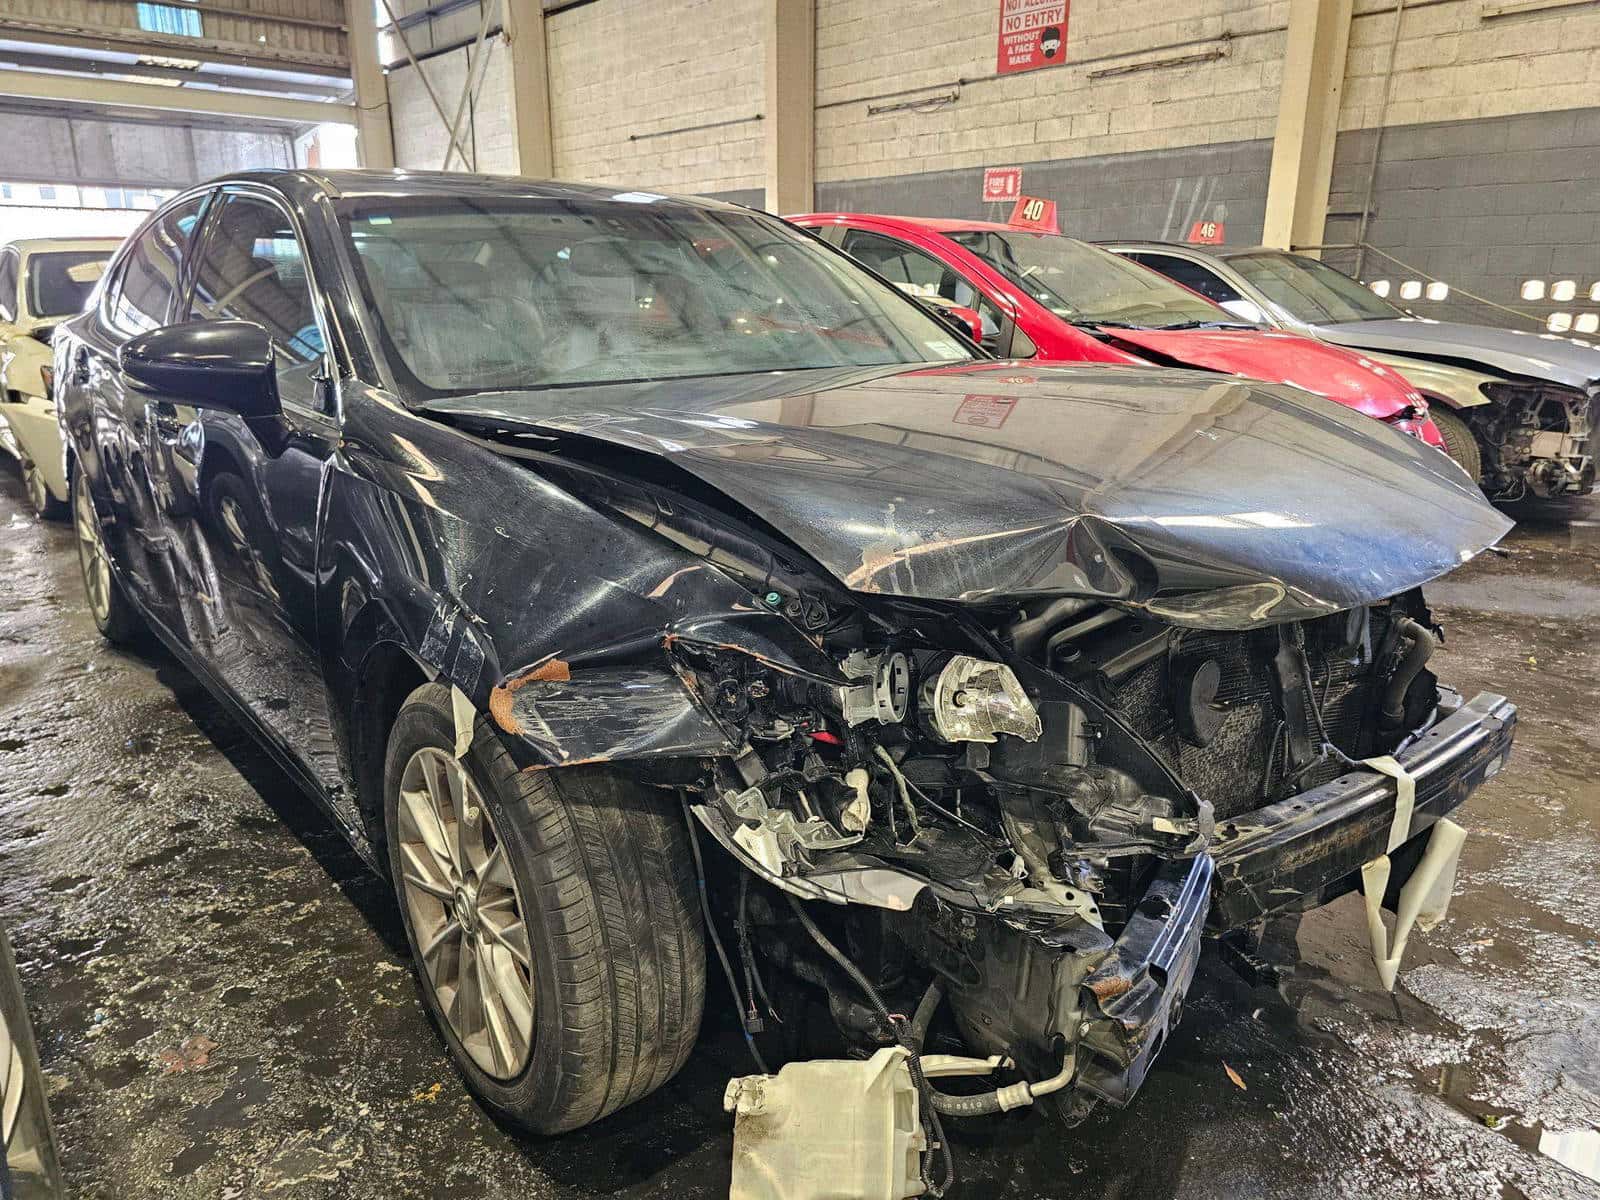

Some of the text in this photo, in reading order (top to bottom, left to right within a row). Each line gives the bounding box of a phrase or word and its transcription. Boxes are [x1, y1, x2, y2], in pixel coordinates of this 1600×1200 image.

[1006, 8, 1062, 31] NO ENTRY
[1003, 31, 1041, 45] WITHOUT
[1008, 42, 1036, 54] A FACE
[1009, 54, 1032, 65] MASK
[1023, 199, 1044, 221] 40
[1201, 222, 1216, 238] 46
